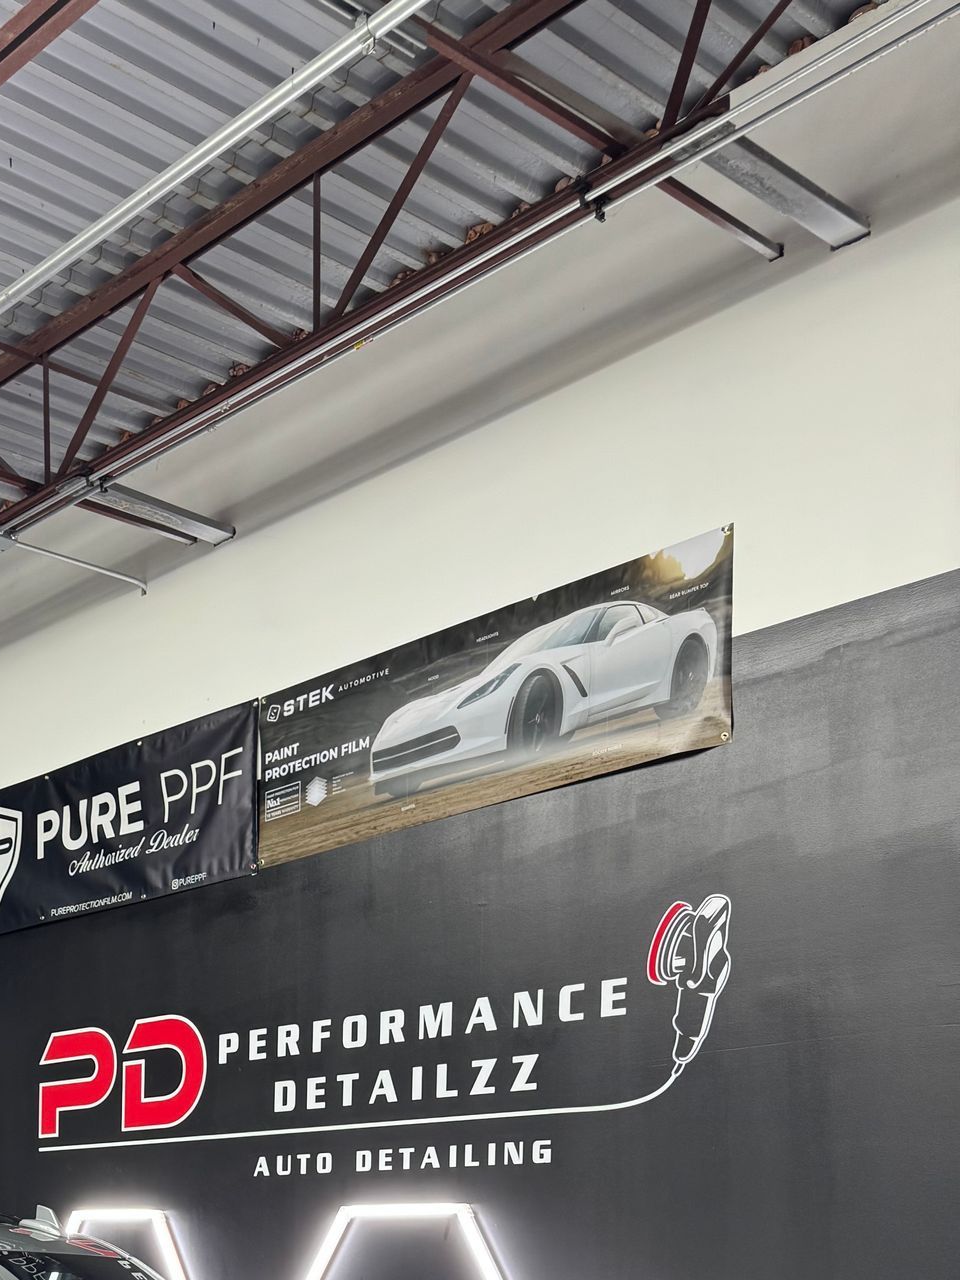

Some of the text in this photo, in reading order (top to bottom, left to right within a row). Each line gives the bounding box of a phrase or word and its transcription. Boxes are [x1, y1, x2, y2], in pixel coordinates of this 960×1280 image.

[283, 668, 390, 717] STEK AUTOMOTIVE
[265, 742, 300, 765] PAINT
[265, 735, 370, 782] PROTECTION FILM
[36, 746, 243, 860] PURE PPF
[68, 823, 200, 877] Authorized Dealer
[50, 891, 133, 917] PUREPROTECTIONFILM.COM
[218, 977, 628, 1065] PERFORMANCE
[38, 1014, 207, 1138] PD
[273, 1053, 539, 1114] DETAILZZ
[253, 1139, 554, 1178] AUTO DETAILING
